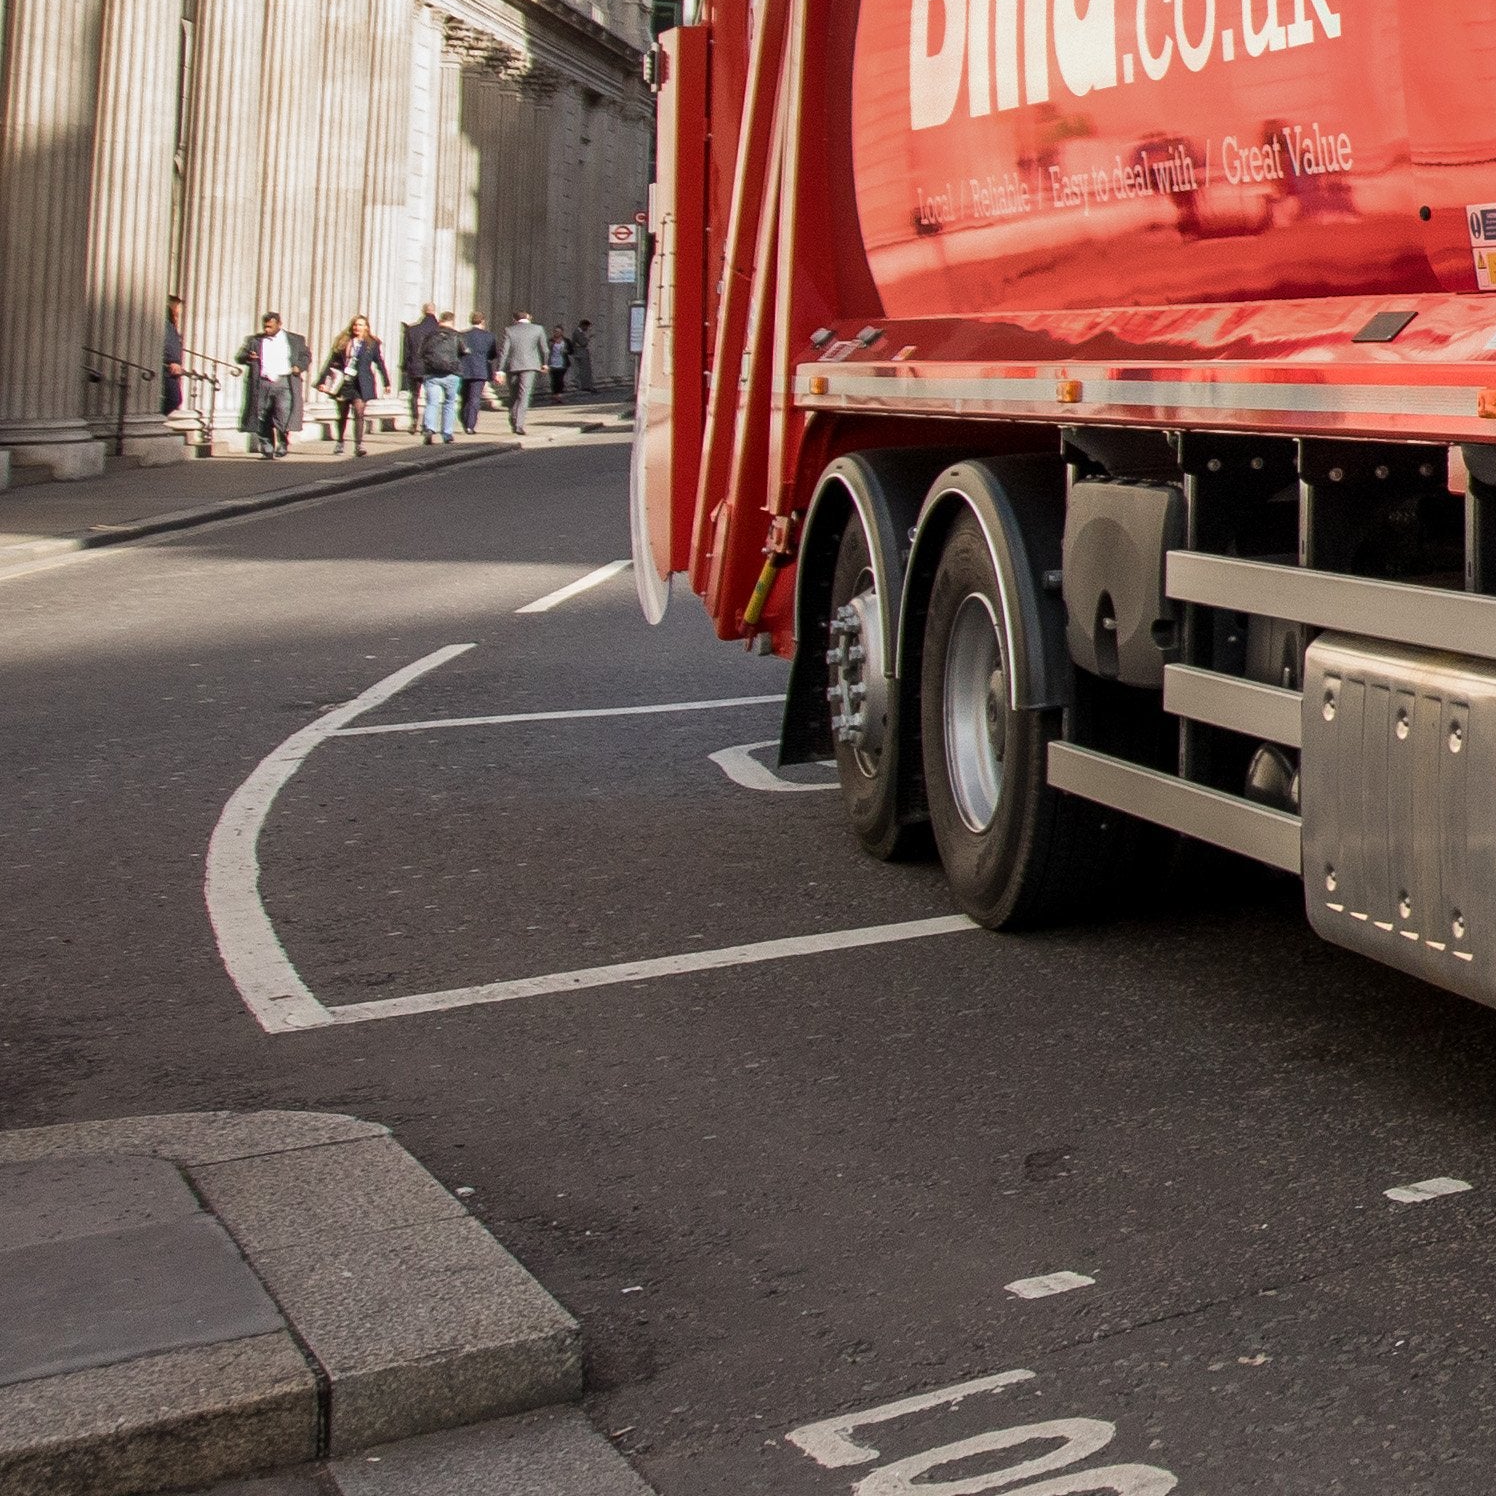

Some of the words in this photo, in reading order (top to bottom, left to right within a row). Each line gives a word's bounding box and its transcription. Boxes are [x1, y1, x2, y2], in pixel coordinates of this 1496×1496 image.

[917, 185, 955, 225] Local
[970, 172, 1031, 218] Reliable
[1049, 165, 1089, 216] Easy
[1091, 170, 1108, 201] to
[1113, 152, 1152, 199] deal
[1153, 145, 1198, 195] with
[1222, 135, 1283, 185] Great
[1282, 123, 1355, 175] Value
